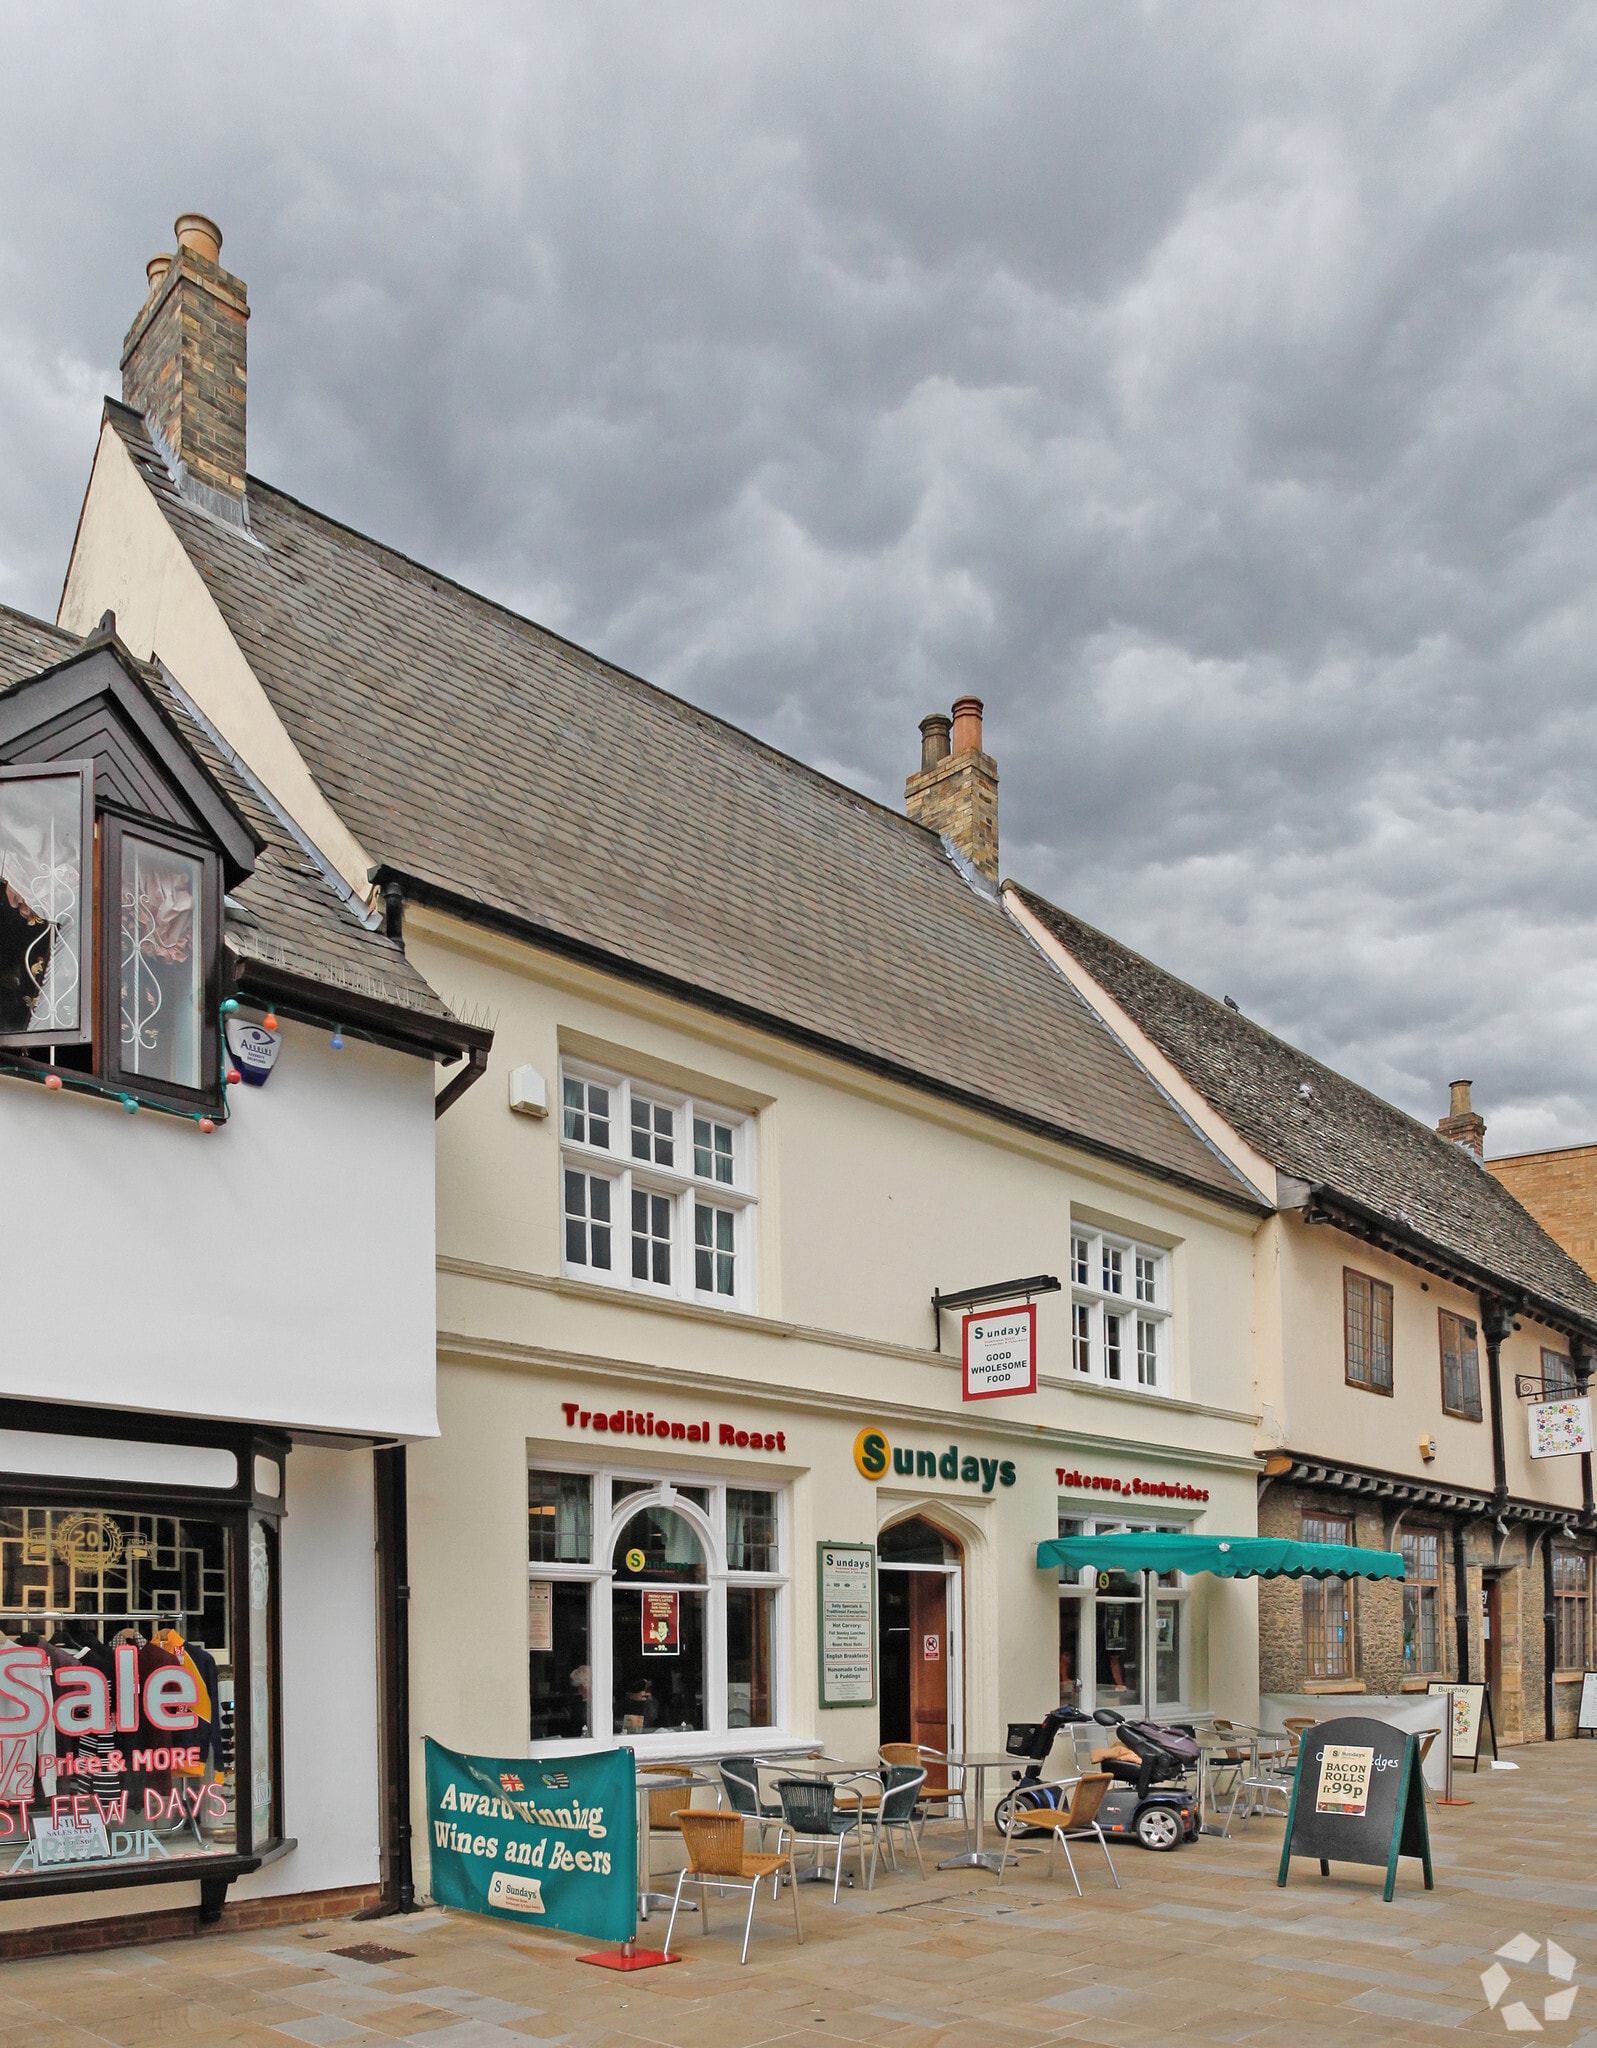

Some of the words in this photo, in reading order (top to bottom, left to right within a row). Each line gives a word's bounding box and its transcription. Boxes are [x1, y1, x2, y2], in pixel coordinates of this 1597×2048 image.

[974, 1325, 1028, 1340] Sundays
[986, 1351, 1012, 1362] GOOD
[970, 1360, 1028, 1375] WHOLESOME
[986, 1373, 1011, 1384] FOOD
[562, 1402, 710, 1443] Traditional
[719, 1423, 786, 1451] Roast
[862, 1434, 1017, 1492] Sundays
[1132, 1477, 1210, 1503] Sandwiches
[826, 1553, 870, 1570] Sundays
[0, 1645, 200, 1738] Sale
[39, 1753, 101, 1778] Price
[107, 1749, 127, 1773] &
[132, 1746, 201, 1772] MORE
[1326, 1763, 1367, 1773] BACON
[1325, 1772, 1365, 1783] ROLLS
[51, 1789, 128, 1831] FEW
[143, 1783, 229, 1821] DAYS
[440, 1783, 515, 1821] Award
[516, 1799, 607, 1839] Winning
[434, 1820, 499, 1859] Wines
[504, 1838, 548, 1868] and
[548, 1841, 611, 1876] Beers
[506, 1884, 537, 1900] Sundays
